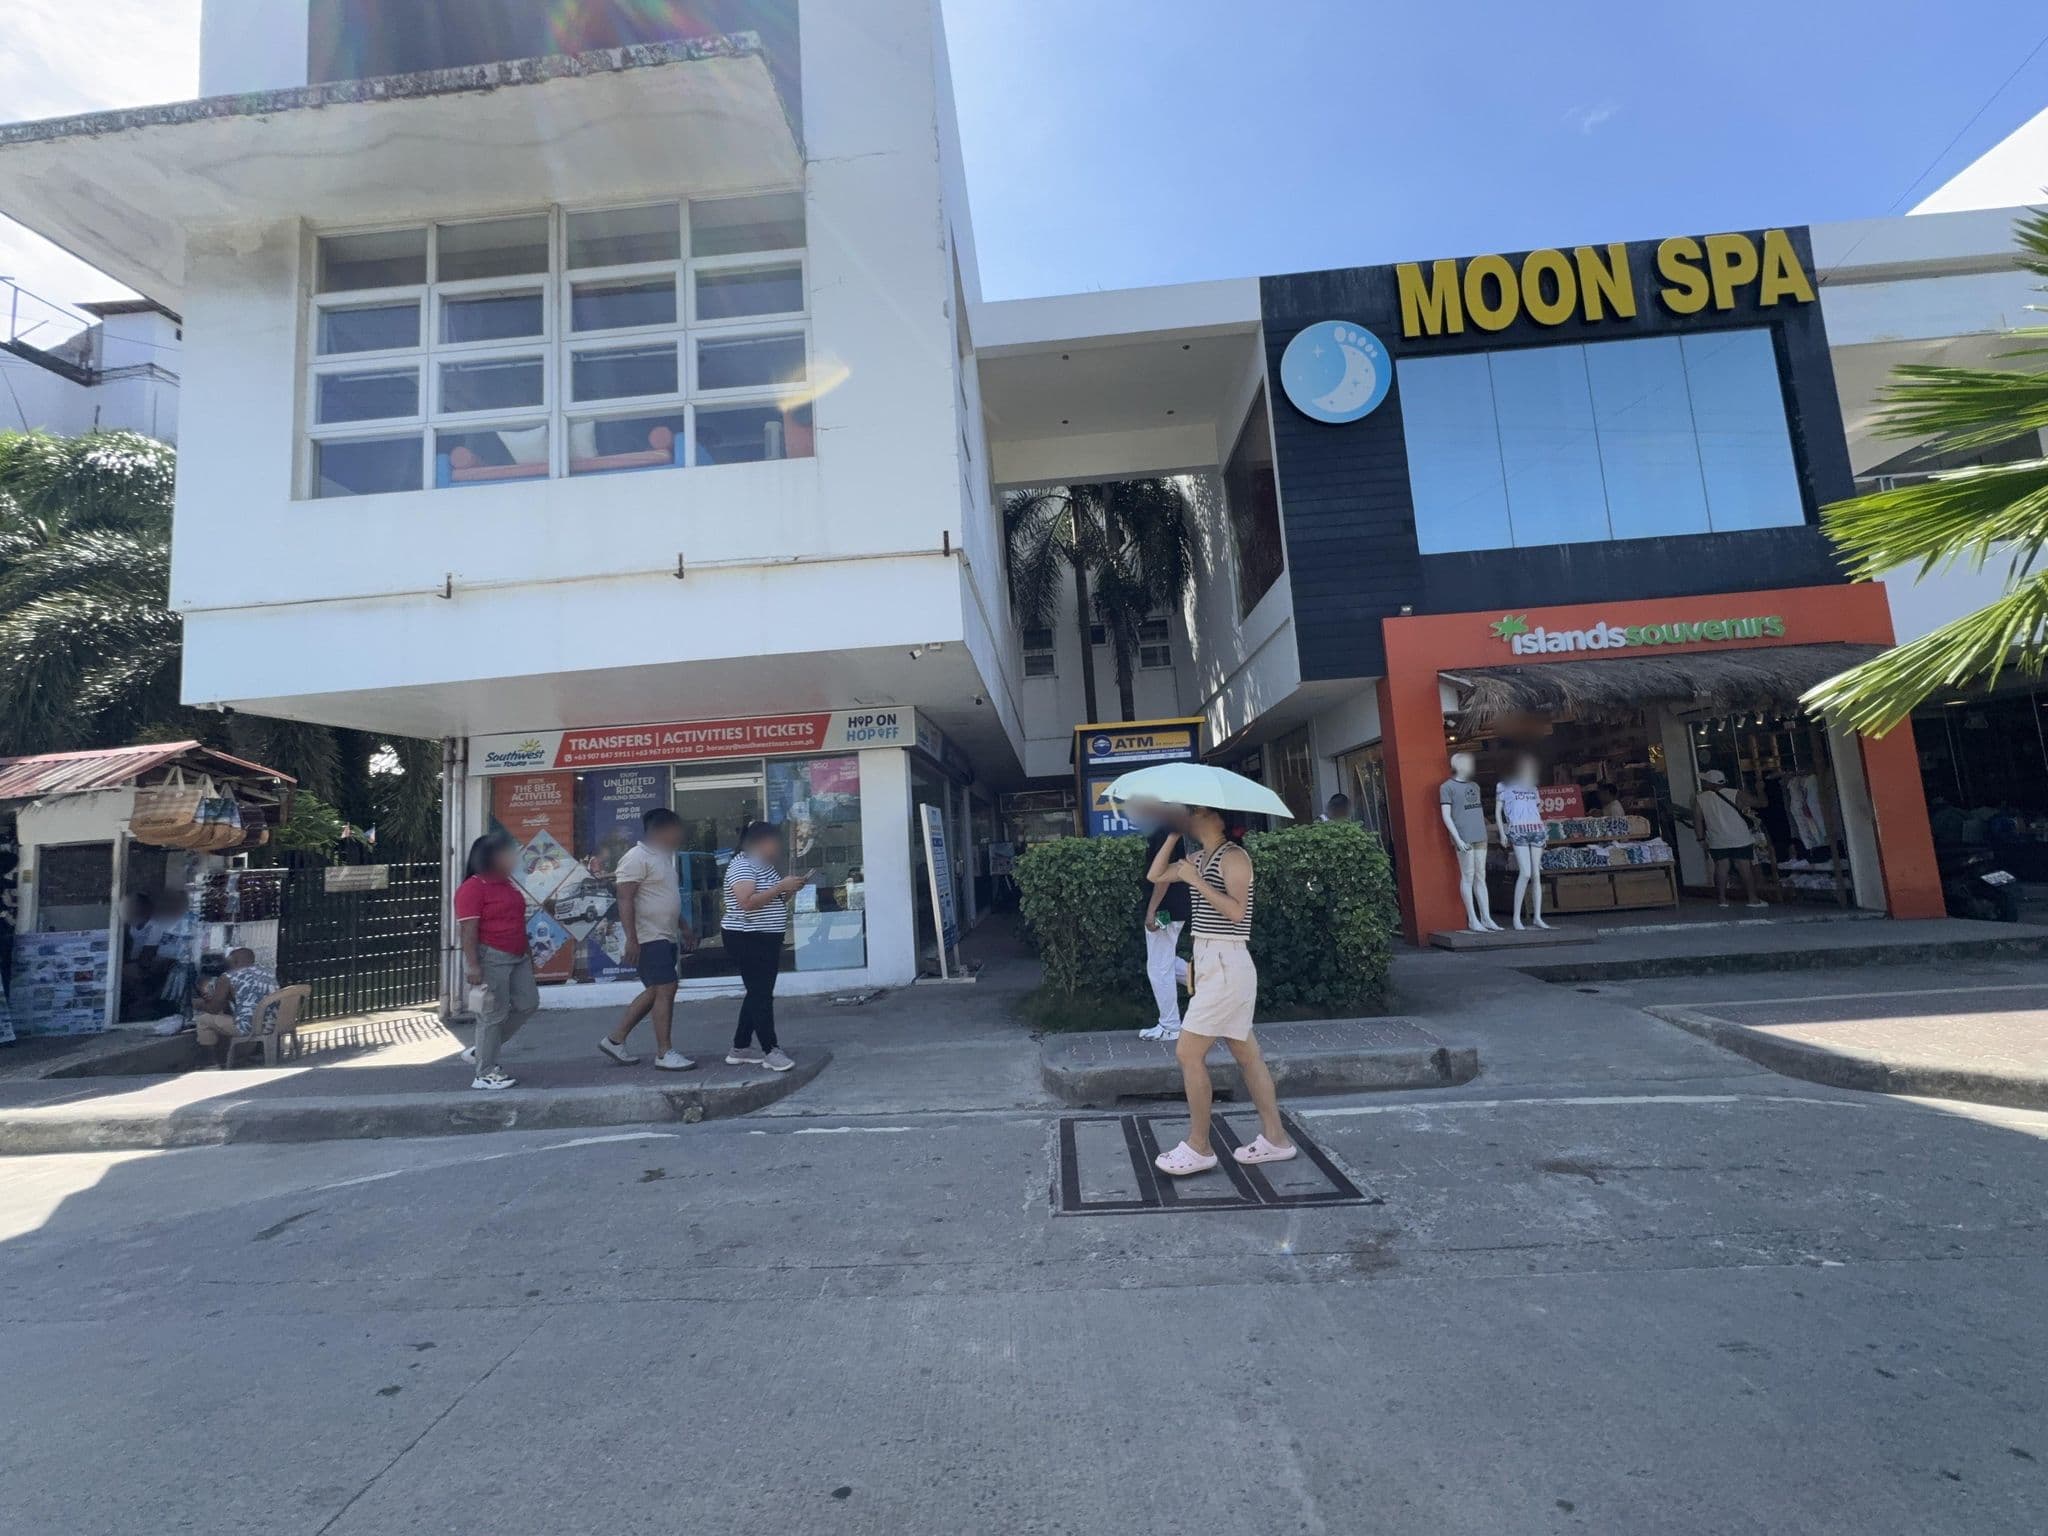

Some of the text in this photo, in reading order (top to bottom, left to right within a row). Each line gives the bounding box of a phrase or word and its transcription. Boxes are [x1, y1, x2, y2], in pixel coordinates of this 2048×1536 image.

[1396, 229, 1817, 338] MOON SPA
[876, 713, 897, 726] ON
[569, 733, 653, 751] TRANSFERS
[662, 727, 743, 744] ACTIVITIES
[753, 722, 814, 738] TICKETS
[847, 729, 875, 742] HOP
[1114, 736, 1154, 750] ATM
[485, 749, 545, 762] Southwest
[513, 782, 557, 794] THE BEST
[603, 776, 656, 788] UNLIMITED
[511, 790, 562, 801] ACTIVITIES
[616, 785, 643, 795] RIDES
